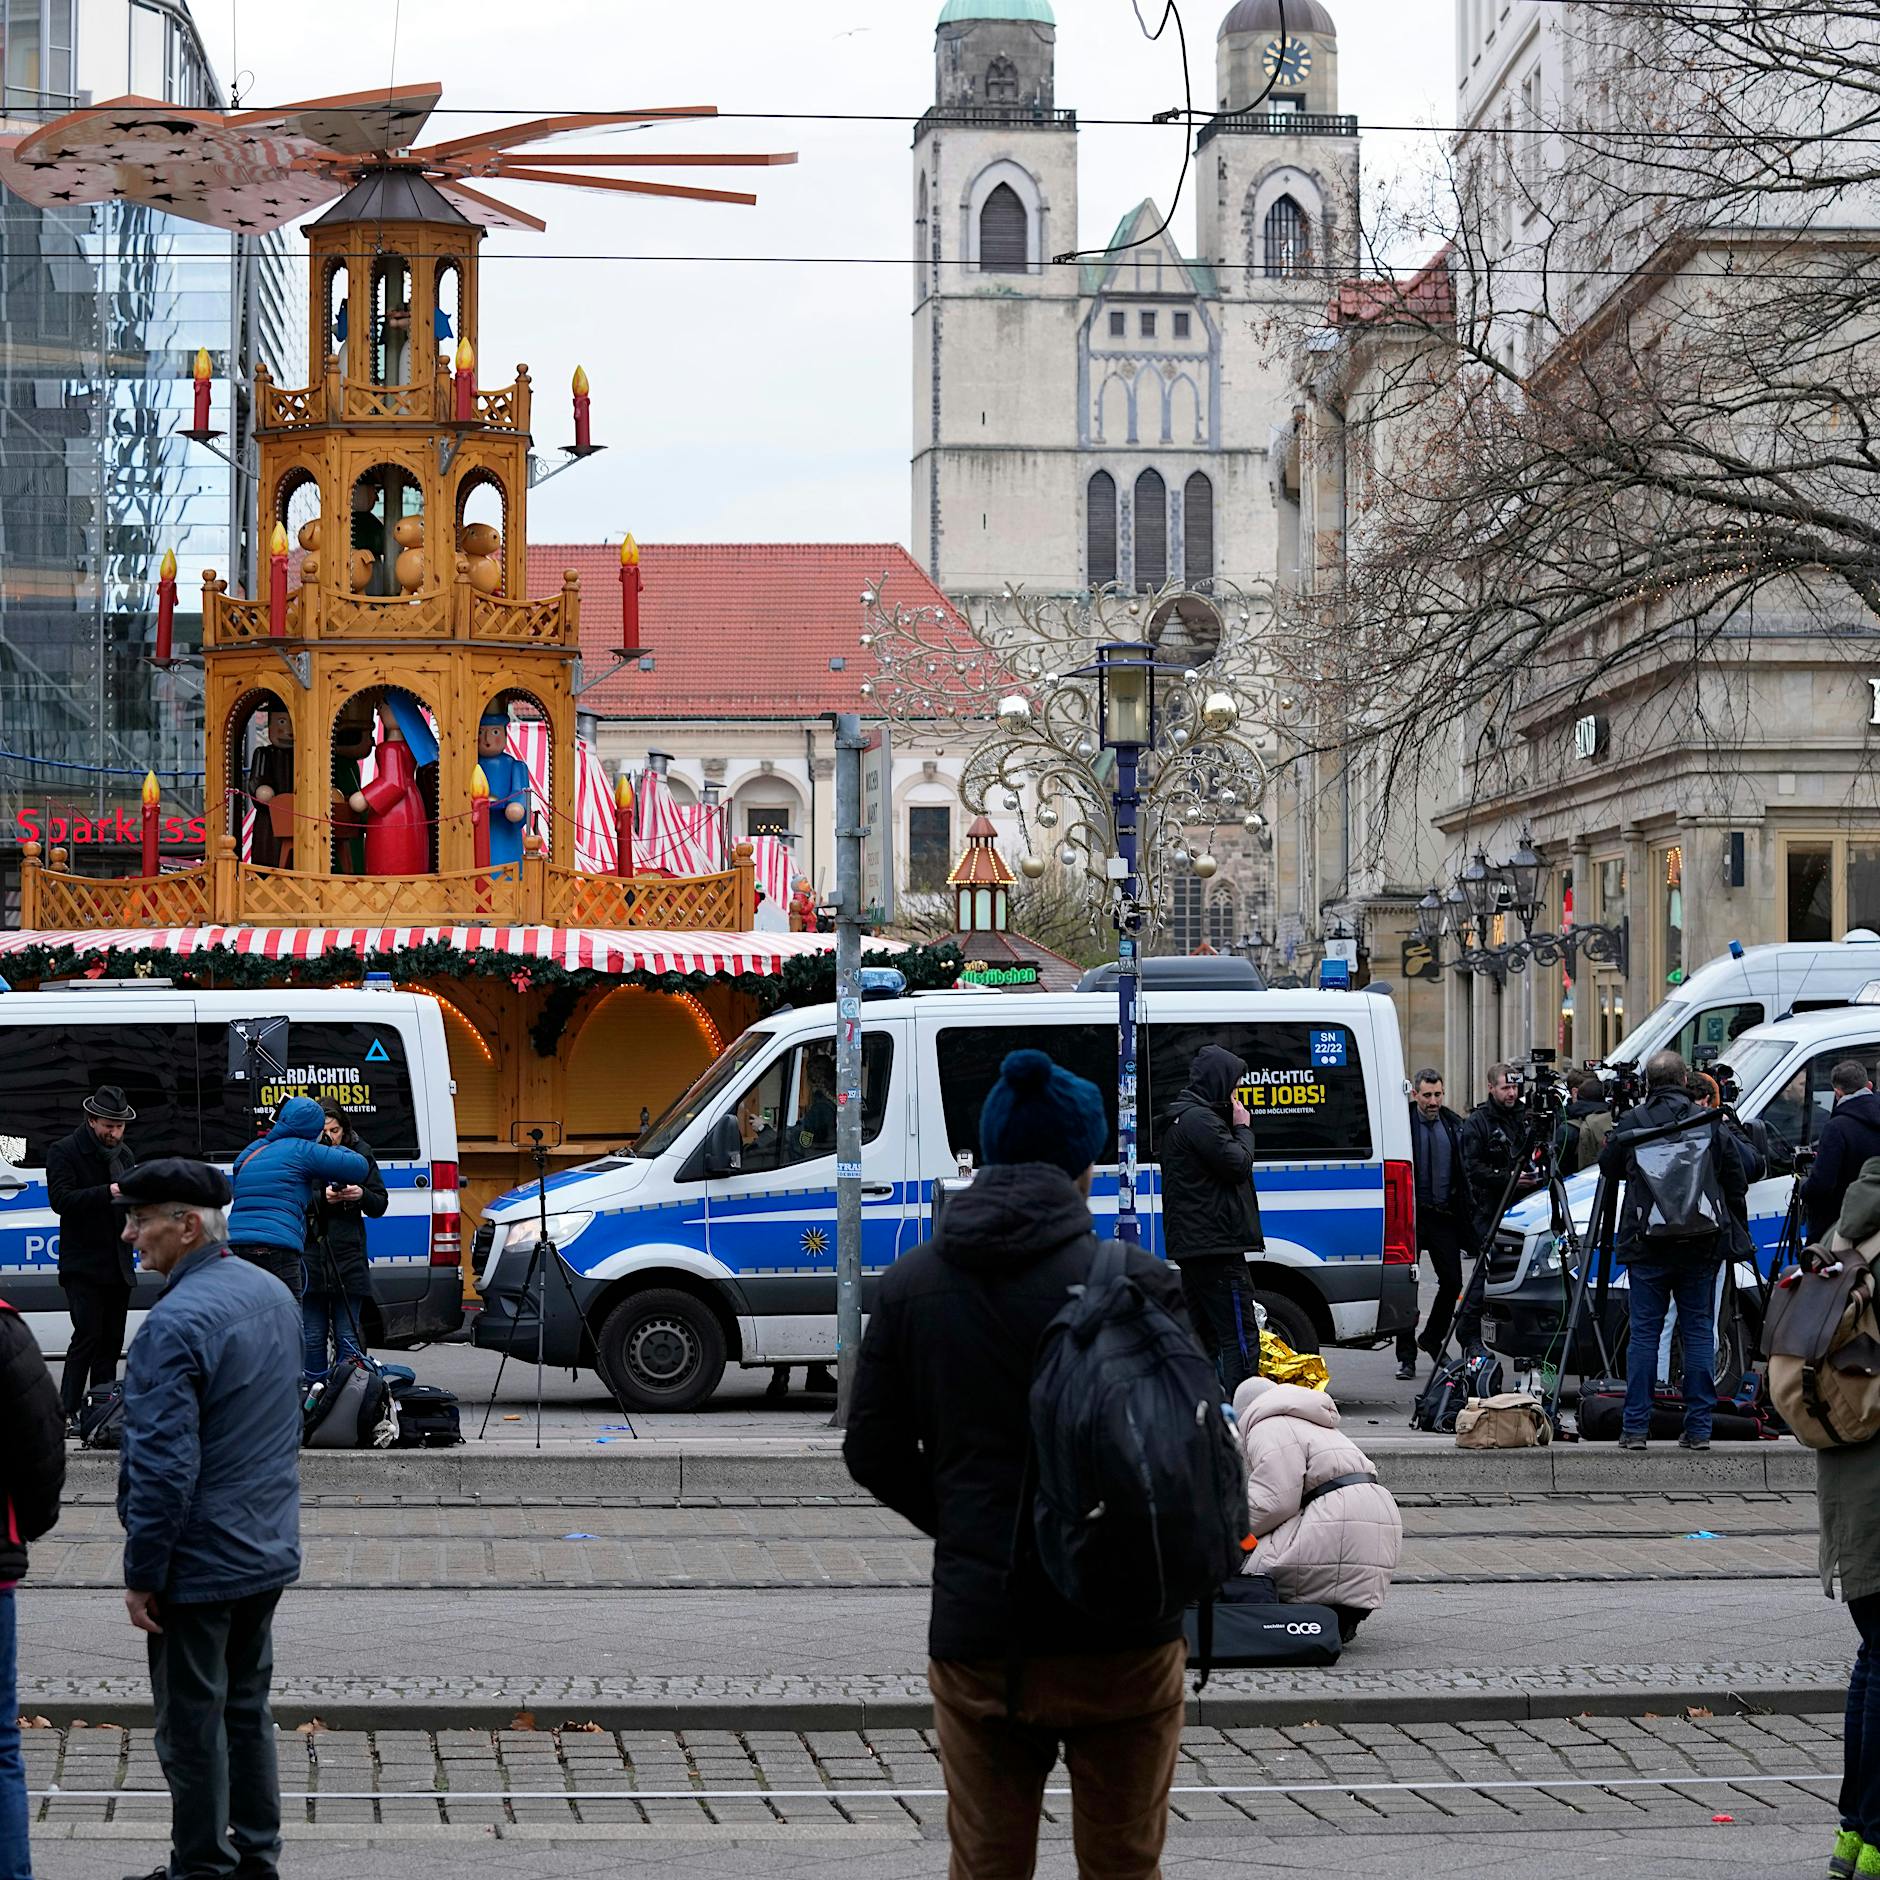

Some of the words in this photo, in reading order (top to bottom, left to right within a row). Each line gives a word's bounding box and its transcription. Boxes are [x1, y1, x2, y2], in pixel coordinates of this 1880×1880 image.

[15, 807, 206, 845] Sparkss
[1320, 1032, 1336, 1042] SN
[1314, 1043, 1343, 1054] 22/22
[1240, 1068, 1314, 1085] RDÄCHTIG
[1270, 1084, 1326, 1107] JOBS!
[1286, 1622, 1322, 1635] ace
